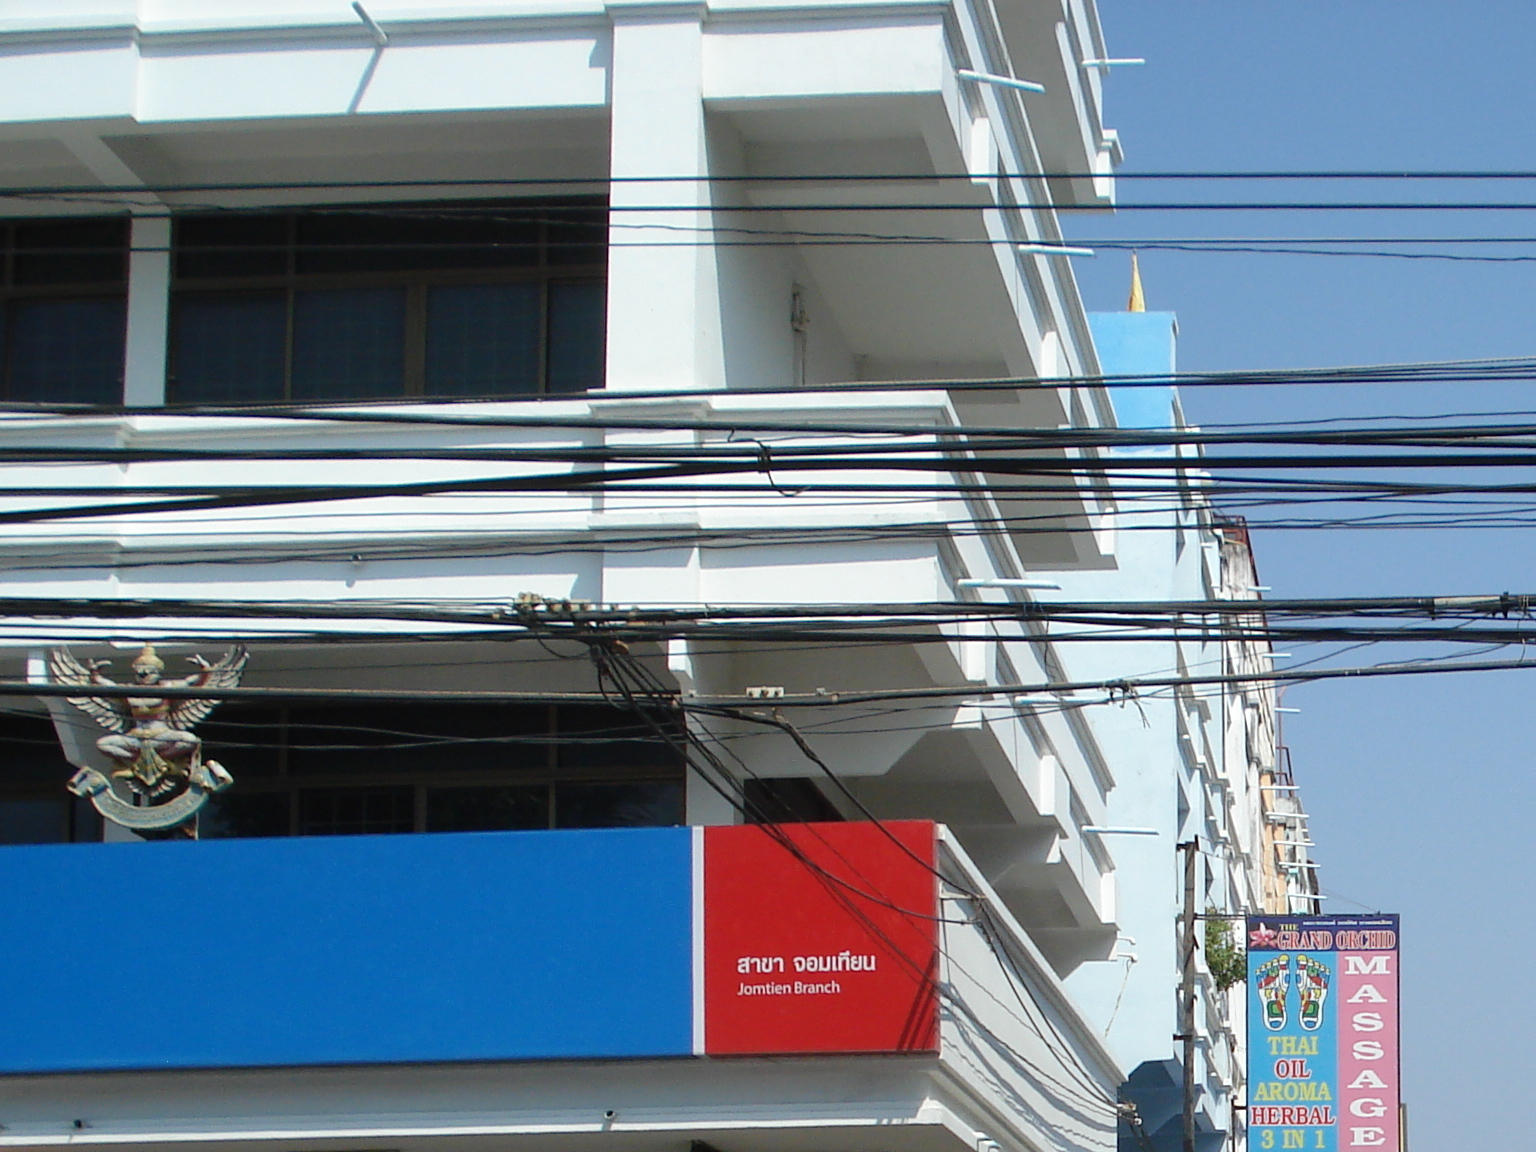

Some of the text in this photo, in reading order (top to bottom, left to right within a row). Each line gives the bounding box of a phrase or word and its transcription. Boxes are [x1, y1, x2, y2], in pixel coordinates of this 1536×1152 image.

[1279, 923, 1299, 931] THE
[1277, 930, 1396, 950] GRAND ORCHID
[737, 950, 876, 973] สาขา จอมเทียน
[737, 980, 841, 996] Jomtien Branch
[1267, 1036, 1319, 1055] THAI
[1345, 955, 1391, 1146] MASSAGE
[1274, 1058, 1312, 1079] OIL
[1254, 1082, 1332, 1101] AROMA
[1250, 1106, 1337, 1126] HERBAL
[1261, 1130, 1326, 1149] 3 IN 1
